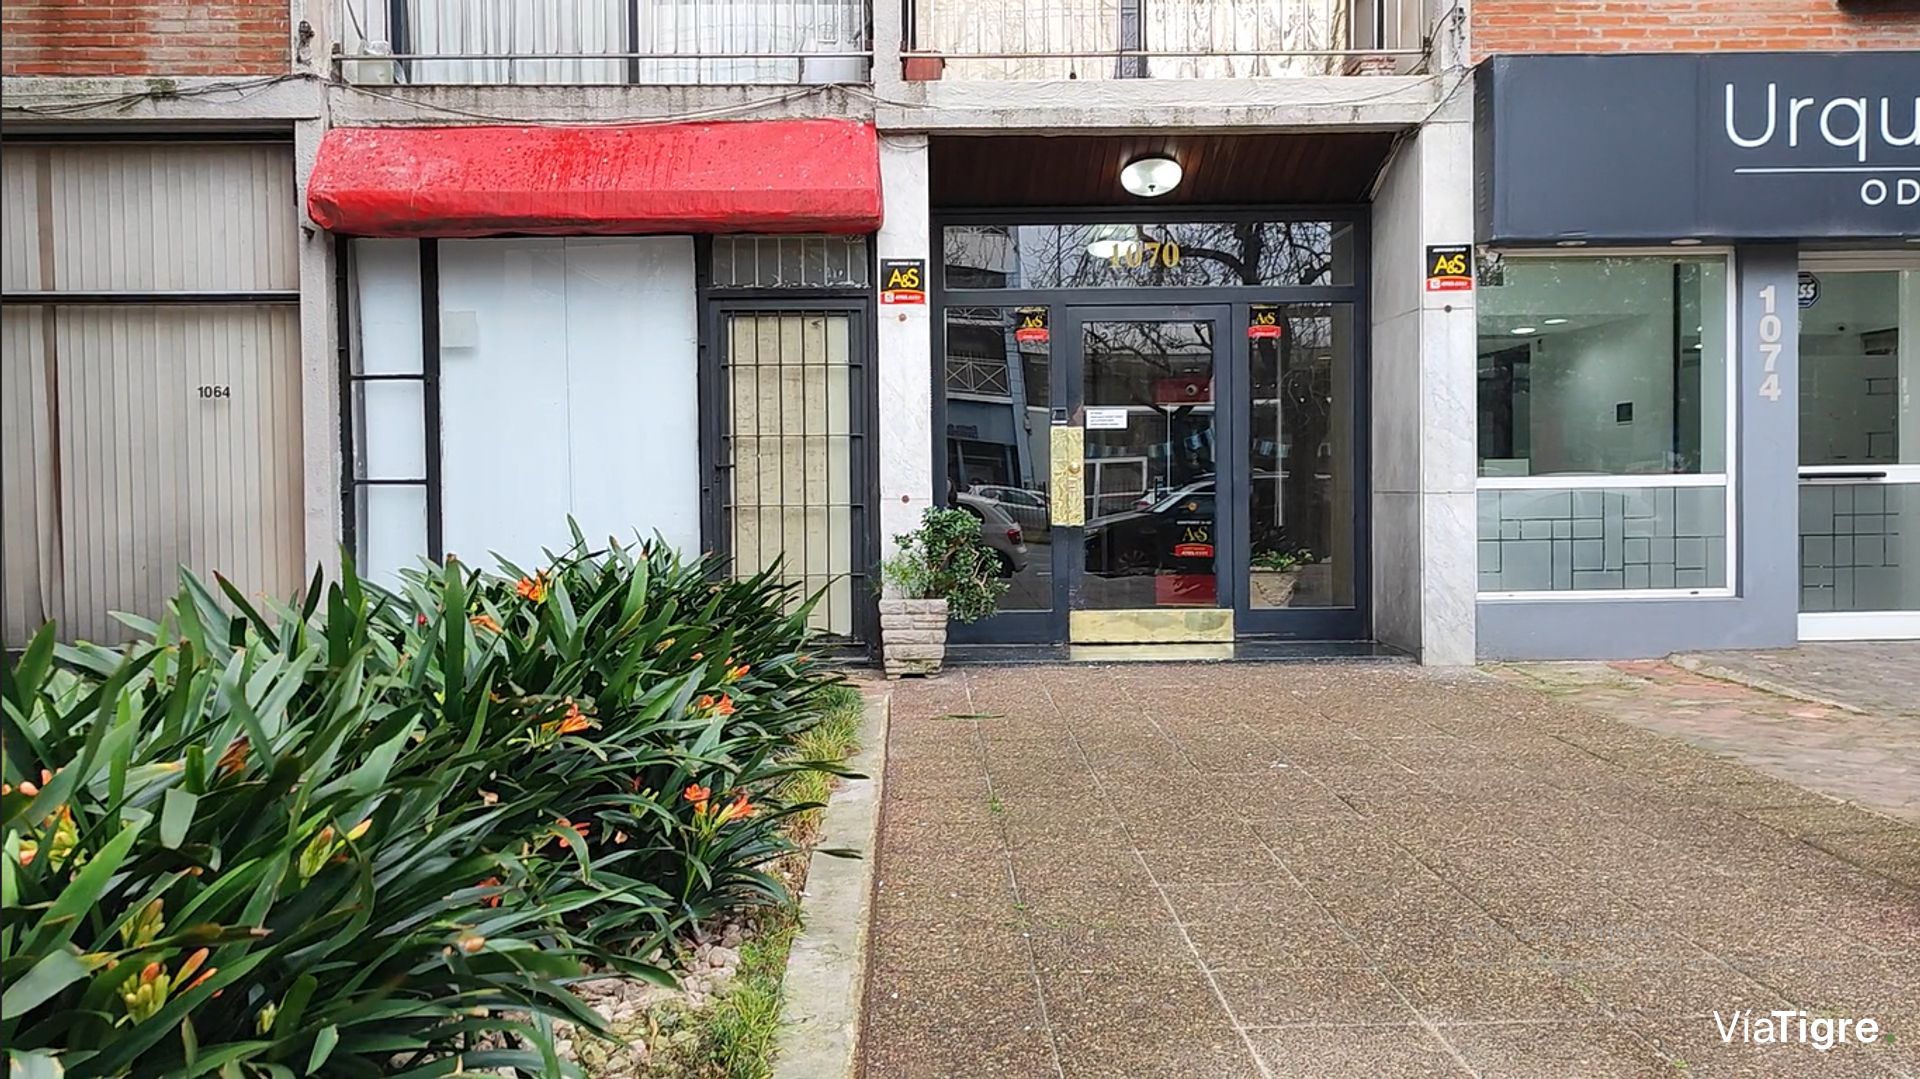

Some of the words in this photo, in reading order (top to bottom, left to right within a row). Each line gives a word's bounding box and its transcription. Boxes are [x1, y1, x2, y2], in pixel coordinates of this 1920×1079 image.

[1725, 82, 1920, 162] Urqu
[1860, 179, 1920, 205] OD
[1108, 241, 1180, 268] 1070
[1433, 254, 1466, 274] A&S
[888, 267, 919, 288] A&S
[1759, 285, 1782, 402] 1074
[197, 385, 231, 398] 1064
